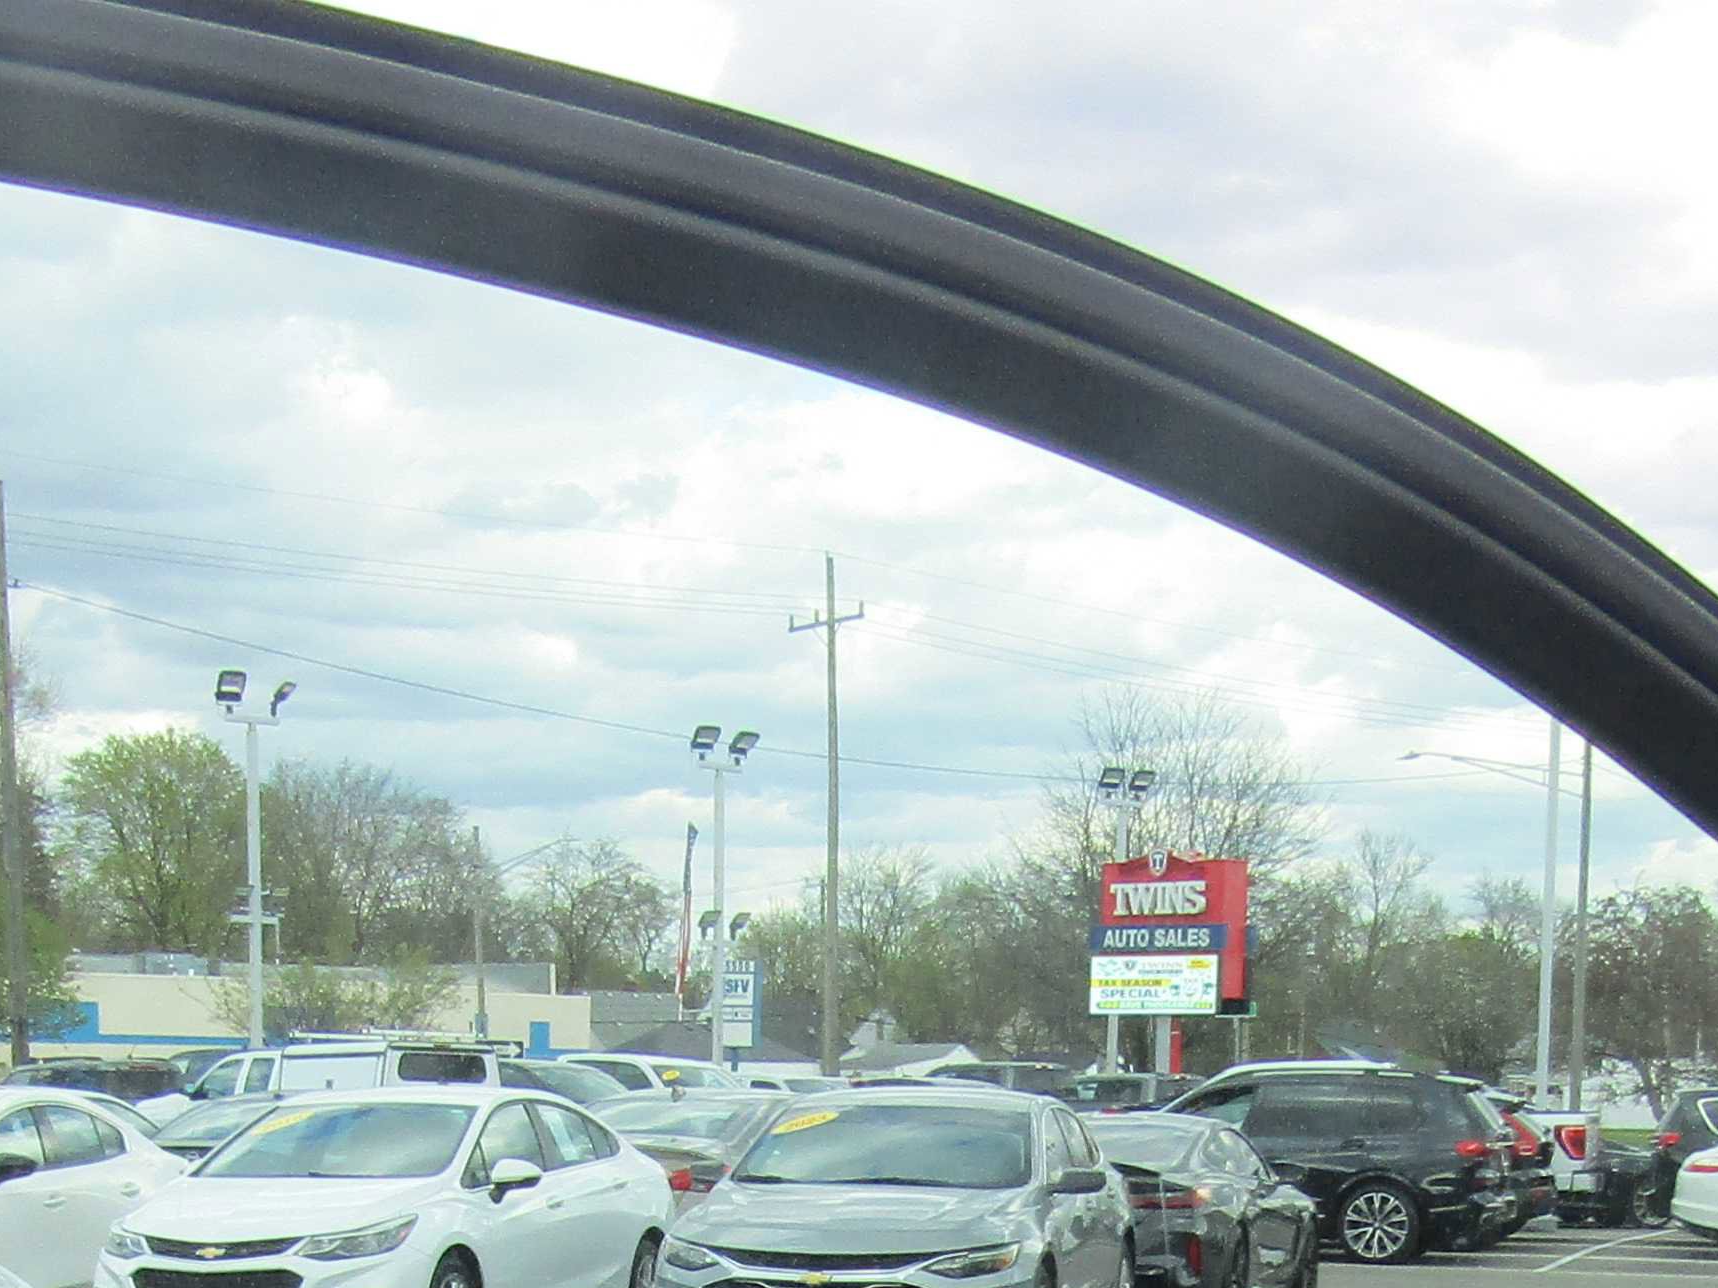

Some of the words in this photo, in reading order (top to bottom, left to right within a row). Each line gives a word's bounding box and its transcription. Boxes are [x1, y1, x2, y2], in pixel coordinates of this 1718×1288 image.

[1109, 880, 1207, 916] TWINS
[1103, 929, 1149, 948] AUTO
[1154, 928, 1210, 948] SALES
[1120, 979, 1163, 988] SEASON
[1099, 988, 1162, 999] SPECIAL
